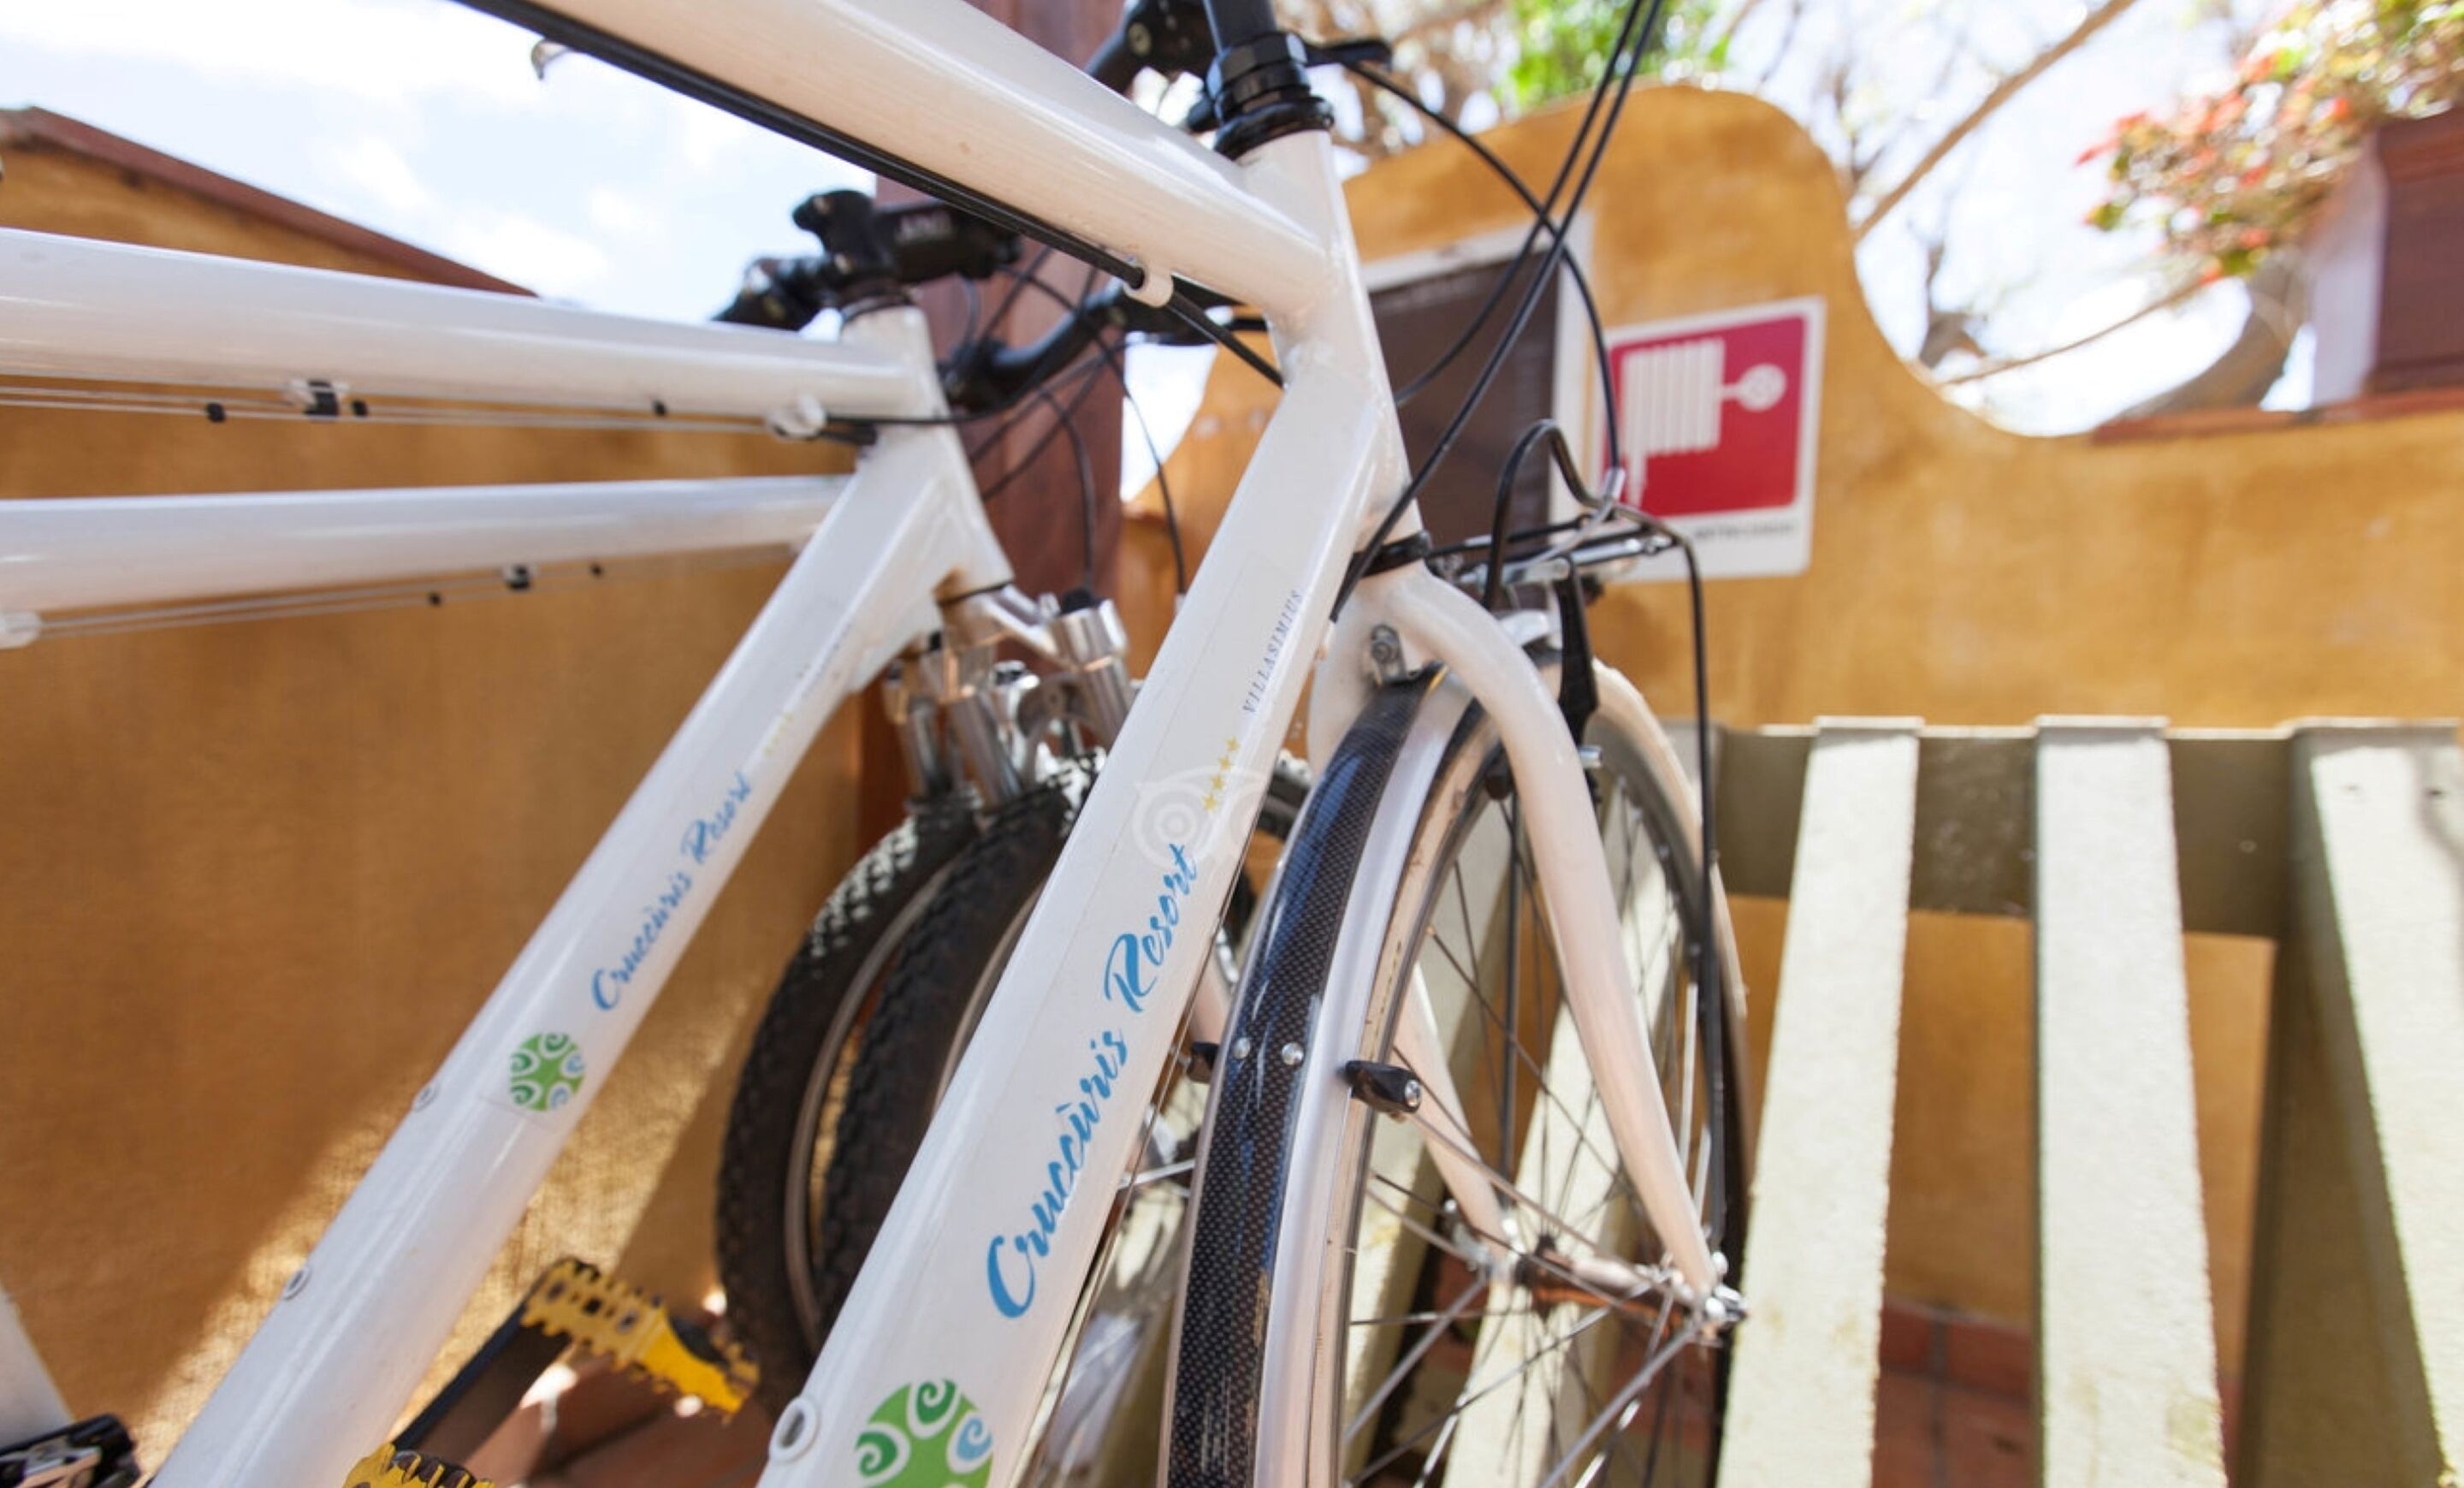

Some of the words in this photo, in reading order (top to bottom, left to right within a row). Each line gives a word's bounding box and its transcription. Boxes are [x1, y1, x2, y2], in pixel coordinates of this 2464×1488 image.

[1242, 589, 1303, 713] VILLASIMIUS
[681, 771, 752, 864] Resort
[985, 1029, 1128, 1319] Cruccùris
[1102, 842, 1198, 1014] Resort
